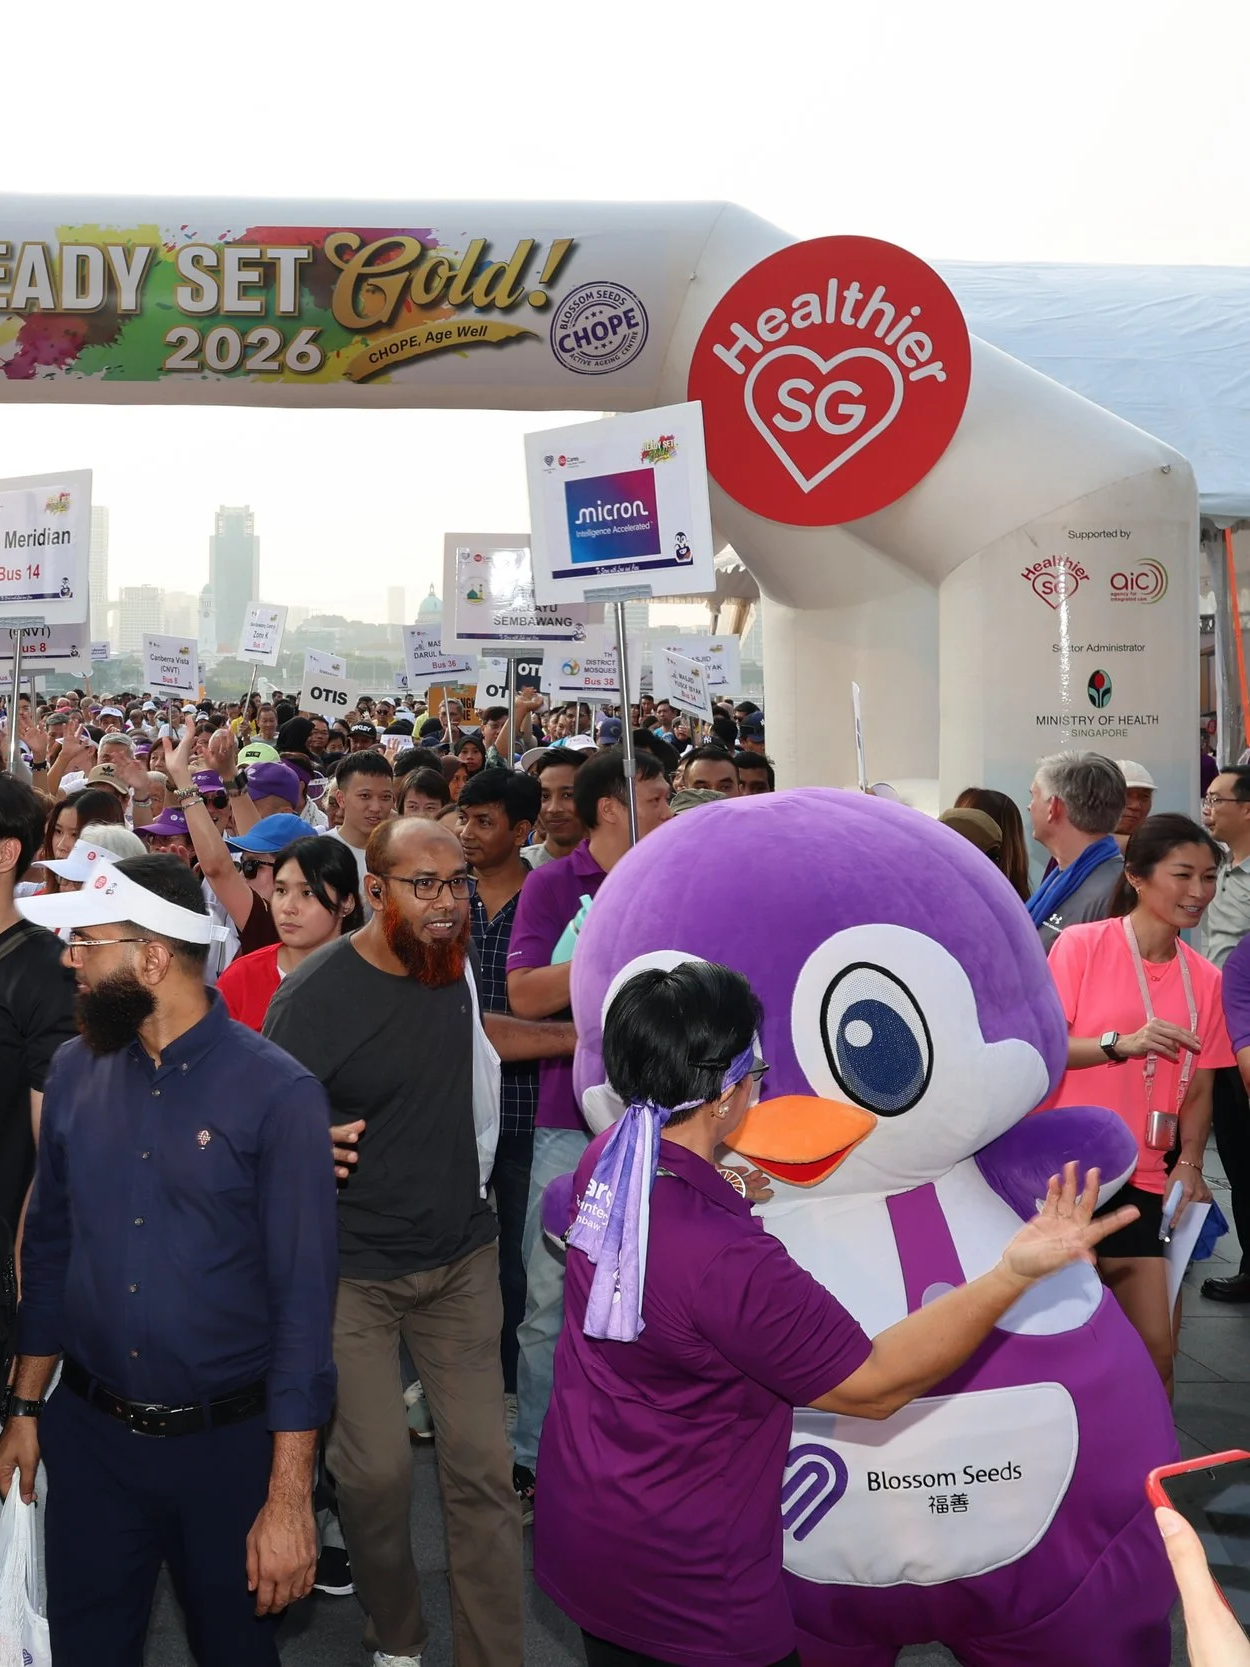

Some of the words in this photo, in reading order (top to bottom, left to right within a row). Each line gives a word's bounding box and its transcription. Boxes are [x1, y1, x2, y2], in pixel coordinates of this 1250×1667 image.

[174, 242, 312, 316] SET
[324, 232, 575, 330] Gold!
[559, 291, 595, 330] BLOSSOM
[596, 290, 627, 306] SEEDS
[558, 307, 640, 353] CHOPE
[712, 278, 947, 387] Healthier
[163, 326, 324, 373] 2026
[368, 335, 421, 364] CHOPE,
[425, 329, 452, 344] Age
[456, 325, 488, 338] Well
[569, 353, 592, 366] ACTIVE
[594, 355, 621, 367] AGEING
[621, 331, 639, 356] CENTRE
[771, 377, 867, 435] SG
[575, 500, 649, 525] micron
[4, 527, 71, 549] Meridian
[576, 527, 612, 539] Intelligence
[612, 521, 651, 534] Accelerated
[1068, 529, 1118, 541] Supported
[1120, 529, 1132, 541] by
[27, 563, 41, 579] 14
[1110, 572, 1150, 590] aic
[494, 616, 573, 627] SEMBAWANG
[9, 627, 51, 639] (NVT)
[39, 643, 47, 653] 8
[414, 651, 437, 660] DARUL
[1052, 644, 1084, 653] Stor
[1086, 644, 1146, 653] Administrator
[150, 654, 175, 663] Canberra
[176, 656, 190, 665] Vista
[432, 661, 446, 669] Bus
[161, 666, 180, 675] (CNVT)
[518, 663, 542, 676] OTI
[163, 675, 172, 683] Bus
[584, 677, 602, 685] Bus
[604, 678, 614, 686] 38
[310, 686, 348, 705] OTIS
[486, 684, 509, 698] OT
[1036, 715, 1095, 725] MINISTRY
[1098, 715, 1115, 725] OF
[1118, 715, 1159, 725] HEALTH
[1071, 729, 1128, 737] SINGAPORE
[867, 1471, 957, 1492] Blossom
[963, 1461, 1022, 1485] Seeds
[928, 1492, 970, 1514] 福善
